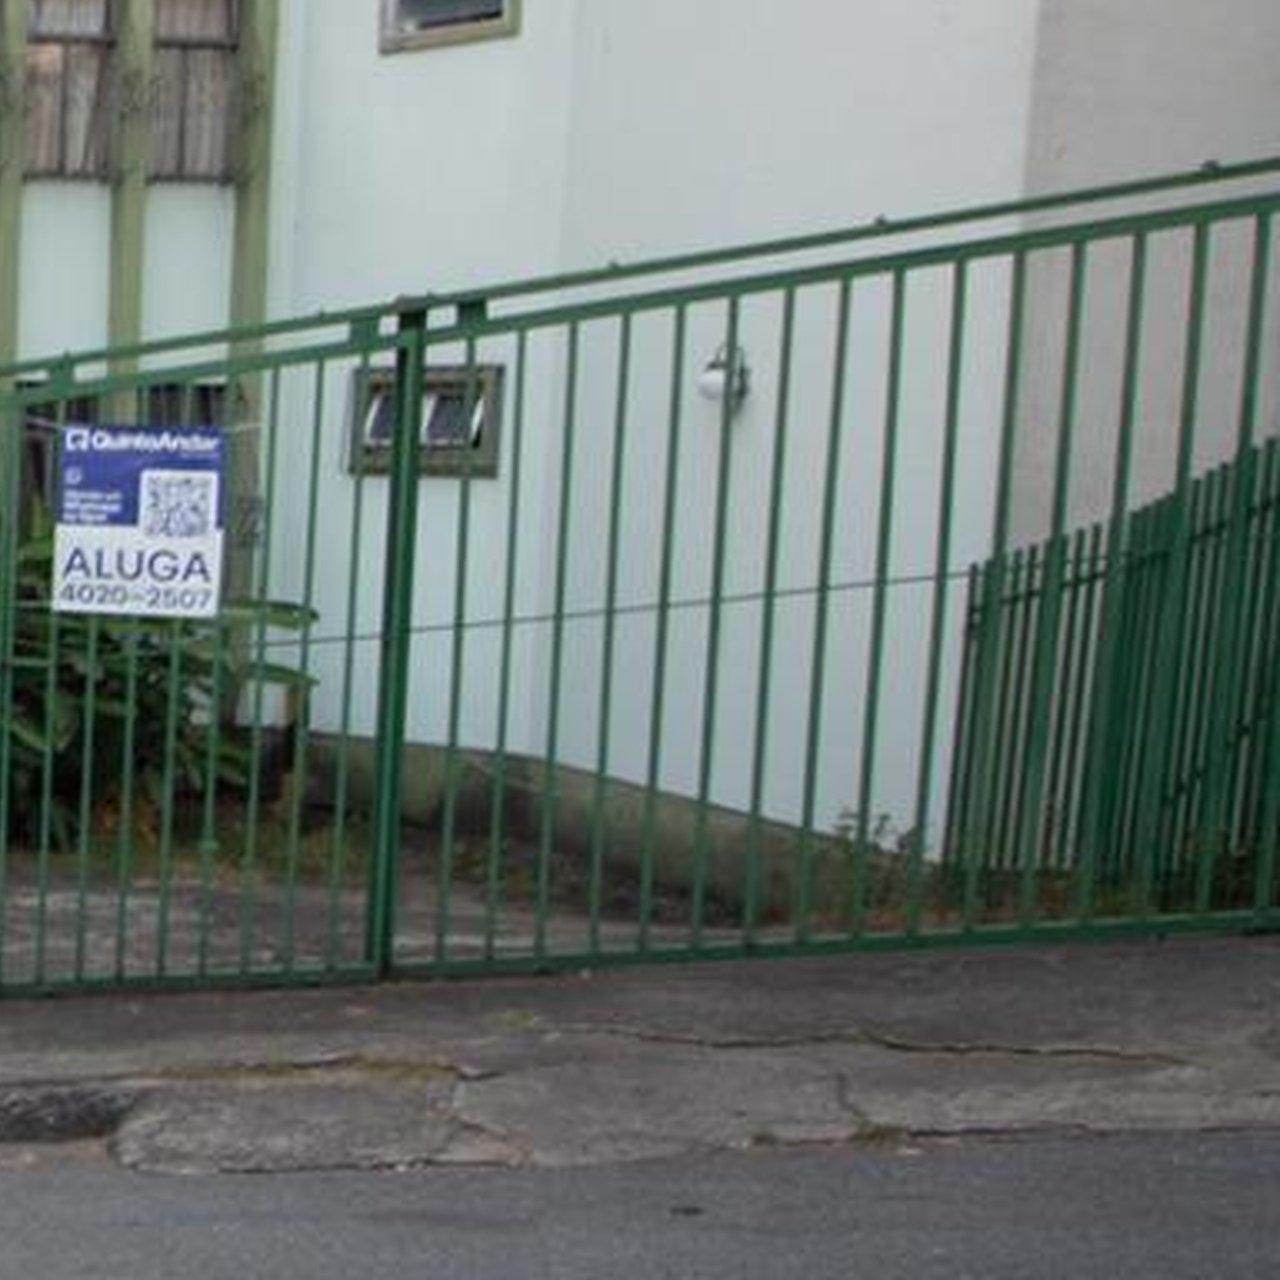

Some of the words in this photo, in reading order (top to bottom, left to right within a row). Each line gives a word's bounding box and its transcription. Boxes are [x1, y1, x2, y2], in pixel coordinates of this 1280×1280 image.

[92, 431, 220, 451] QuintoAndar
[62, 547, 211, 582] ALUGA
[60, 583, 214, 609] 4020-2507
